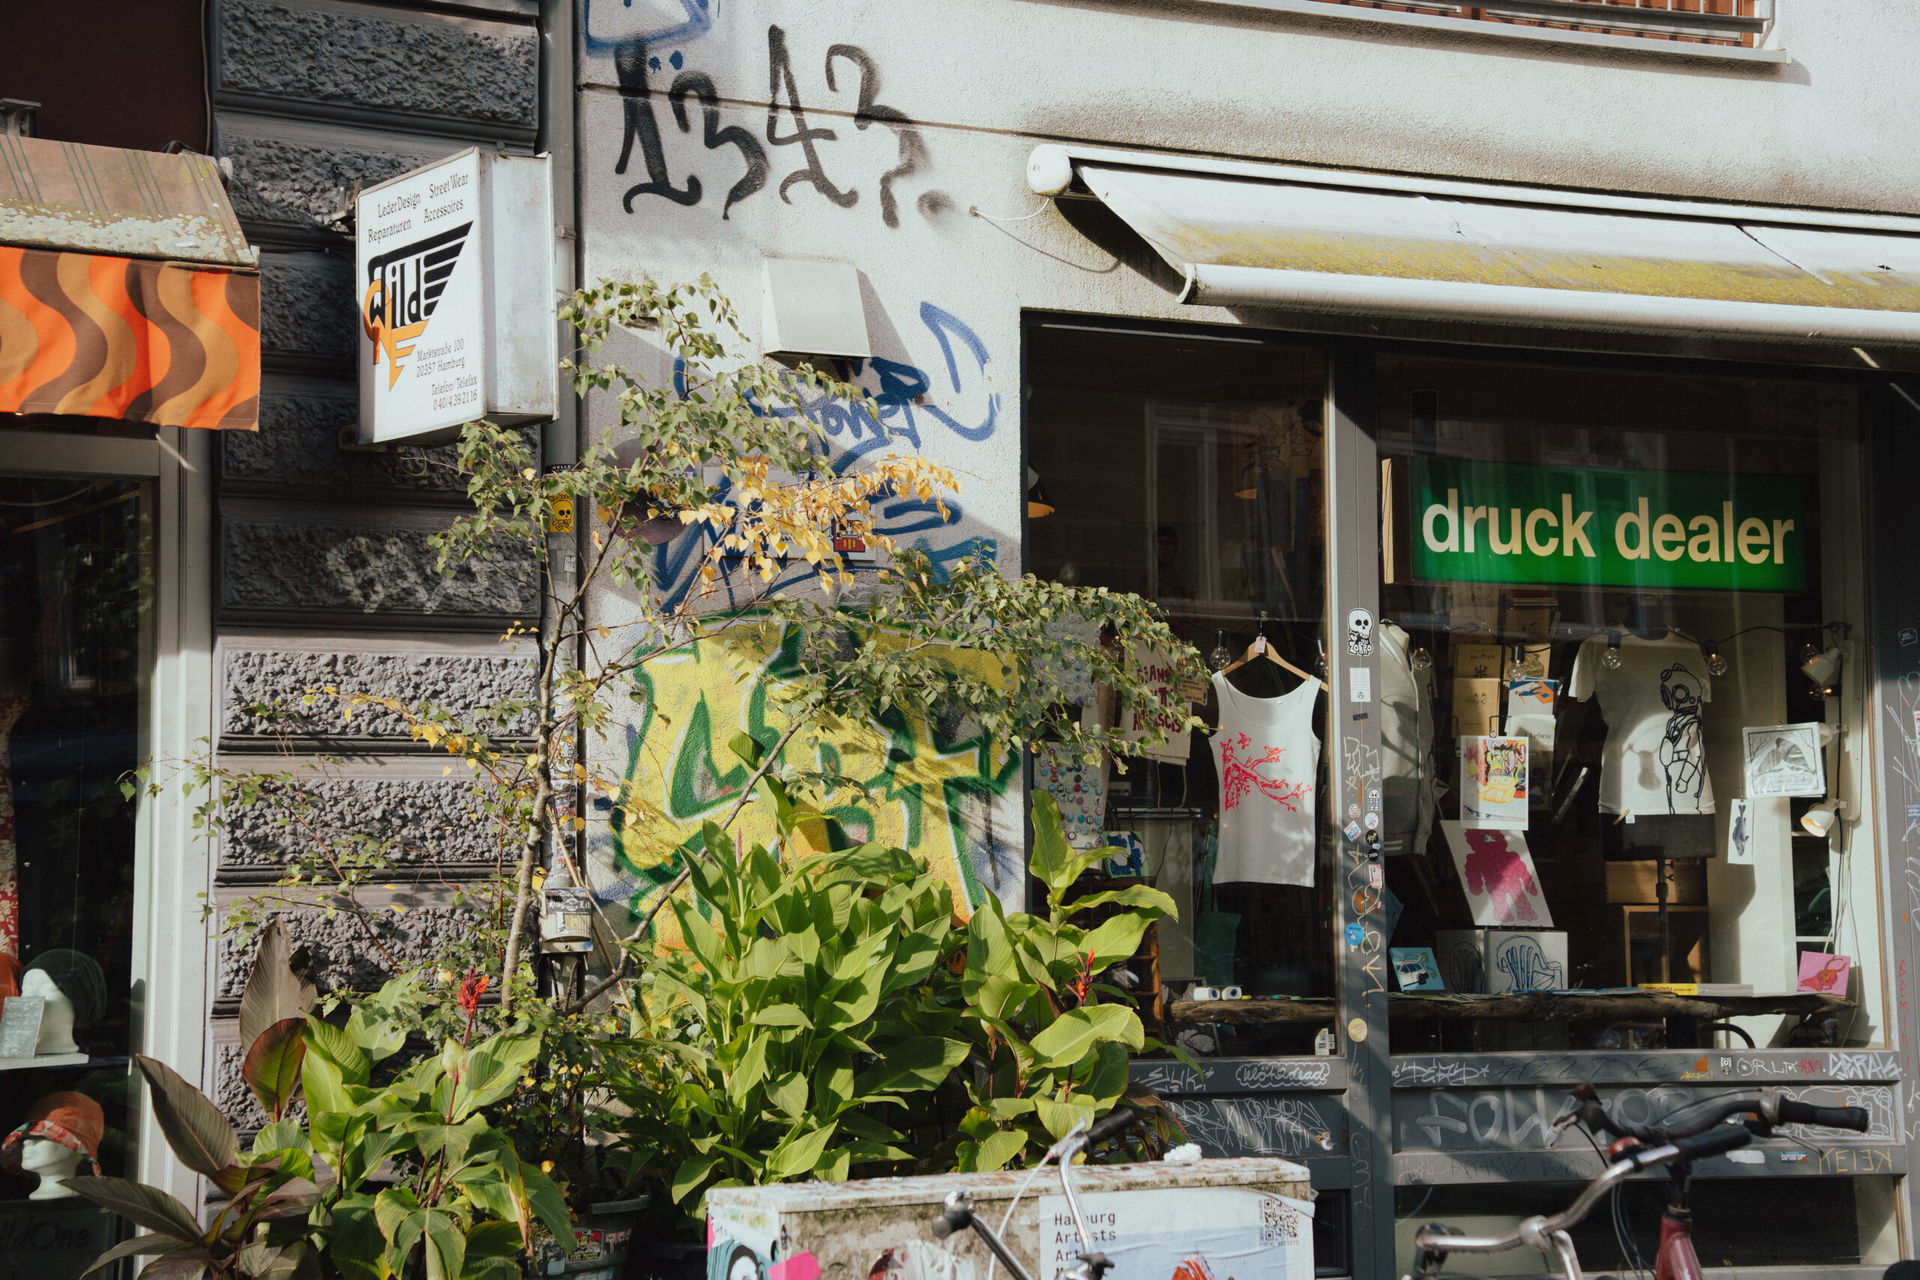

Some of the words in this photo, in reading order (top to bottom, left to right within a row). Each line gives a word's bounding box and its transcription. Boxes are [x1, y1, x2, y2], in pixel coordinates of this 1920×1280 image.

[424, 199, 464, 223] Accessoires
[368, 219, 412, 244] Reparaturen
[438, 356, 465, 372] Hamburg
[1422, 488, 1596, 559] druck
[1614, 497, 1795, 565] dealer
[1054, 1212, 1116, 1226] Haurg
[1055, 1230, 1116, 1244] Artsts
